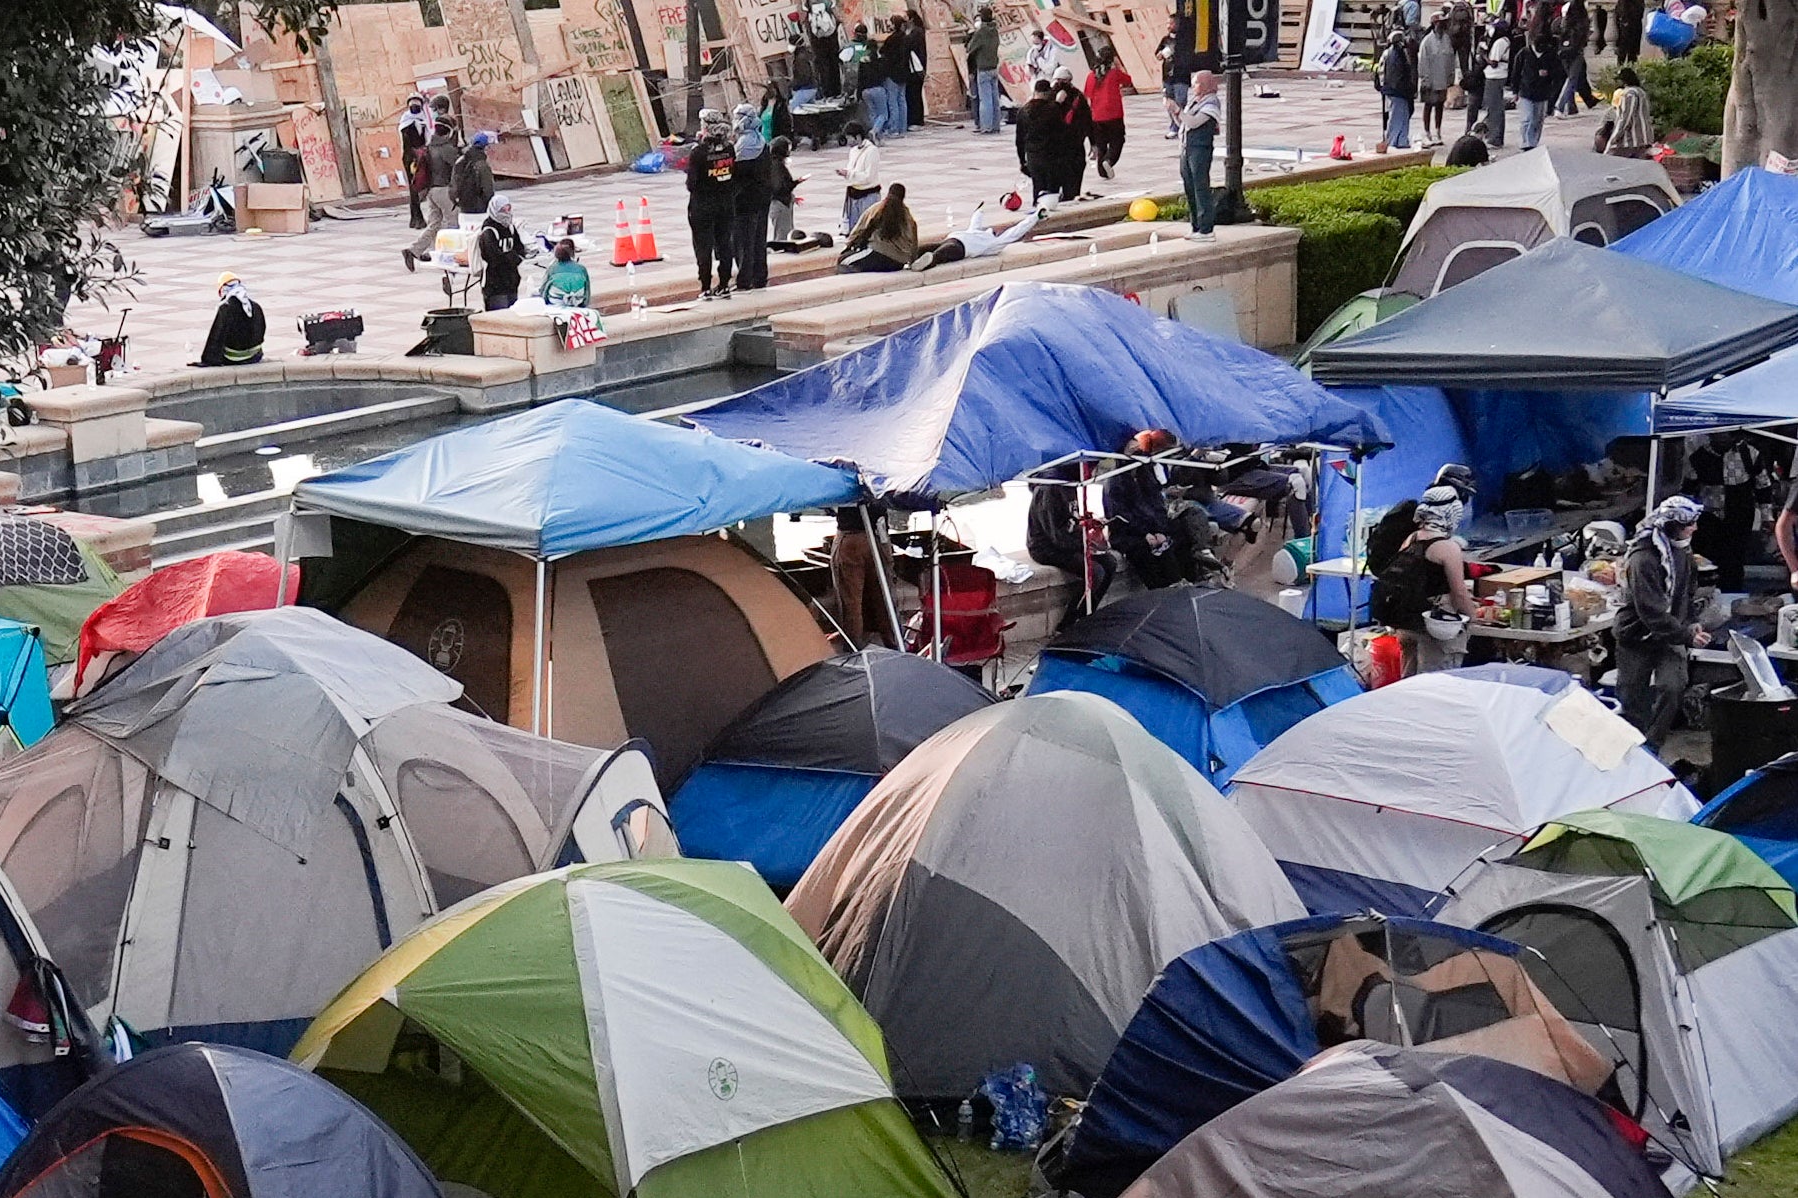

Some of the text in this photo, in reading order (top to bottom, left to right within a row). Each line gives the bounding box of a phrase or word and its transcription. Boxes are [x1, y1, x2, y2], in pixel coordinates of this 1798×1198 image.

[658, 5, 688, 24] FRE
[755, 12, 793, 43] GAZA
[467, 64, 514, 86] BONK
